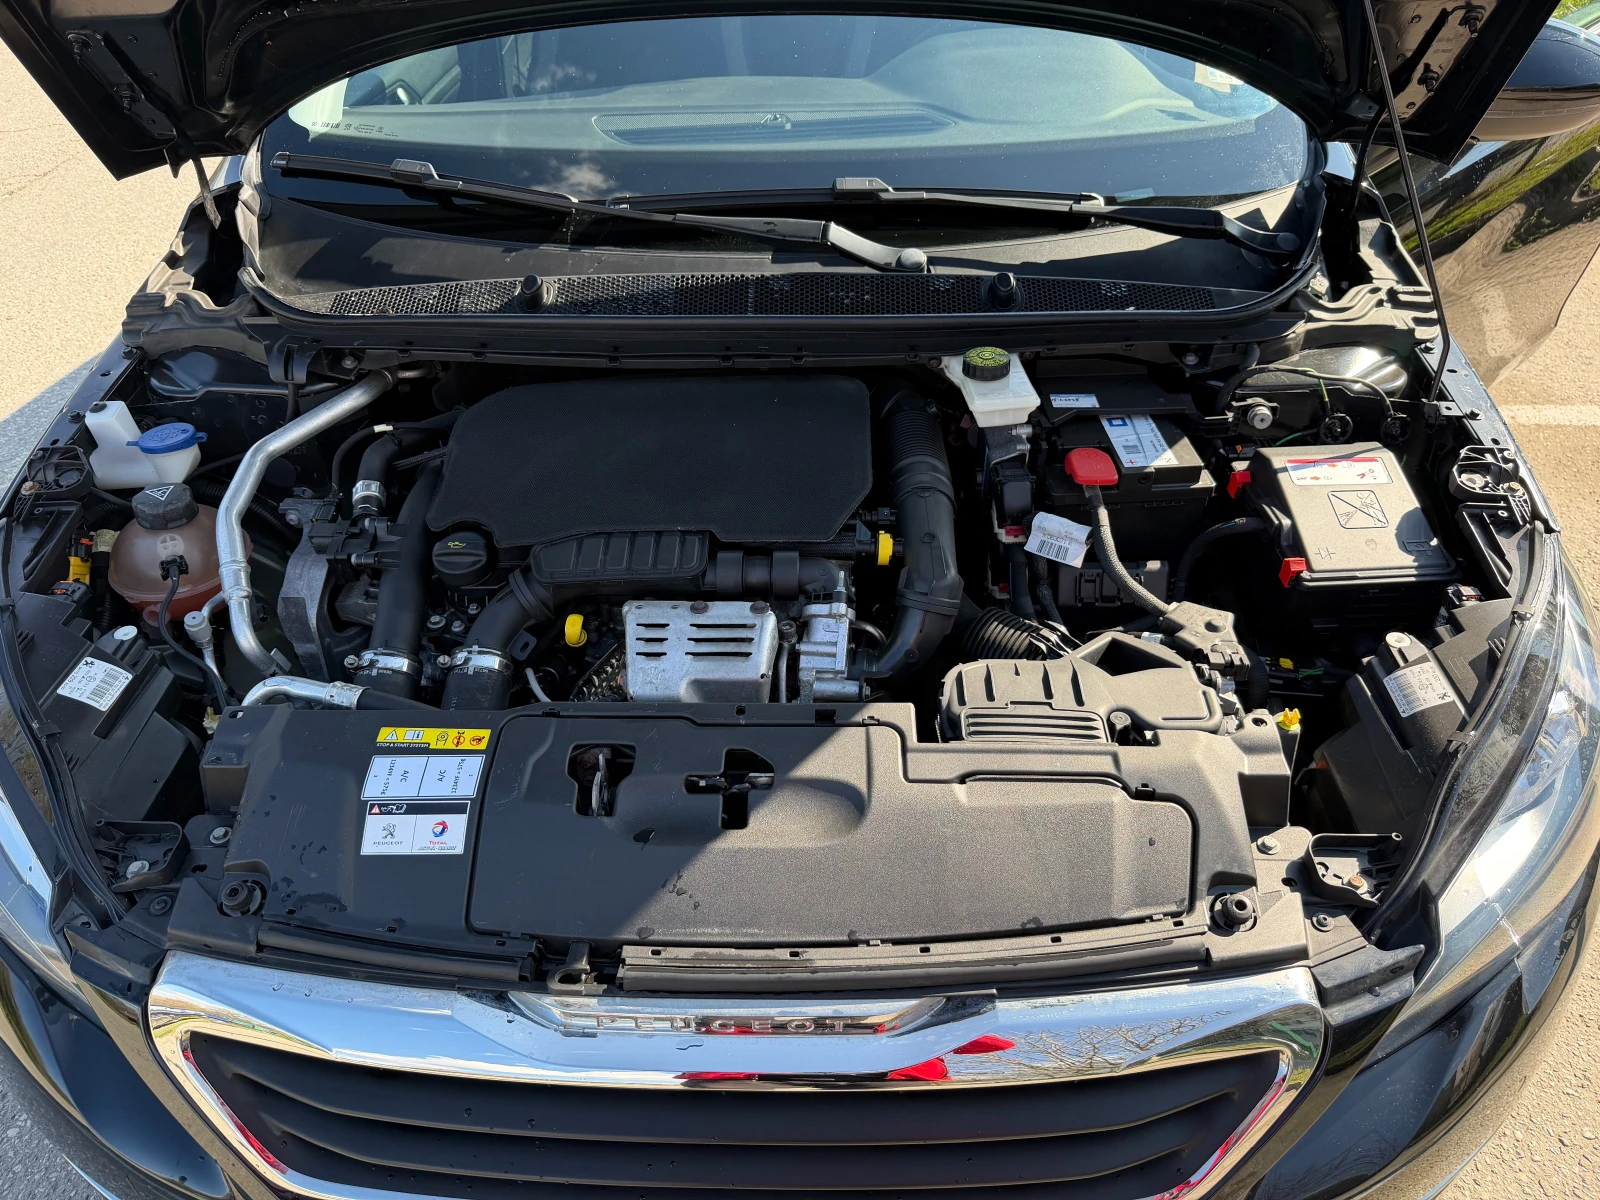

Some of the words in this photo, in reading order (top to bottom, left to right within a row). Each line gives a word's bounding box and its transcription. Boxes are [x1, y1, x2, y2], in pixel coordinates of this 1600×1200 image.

[400, 770, 410, 783] A/C
[437, 769, 447, 783] A/C
[596, 1016, 851, 1033] PEUGEOT
